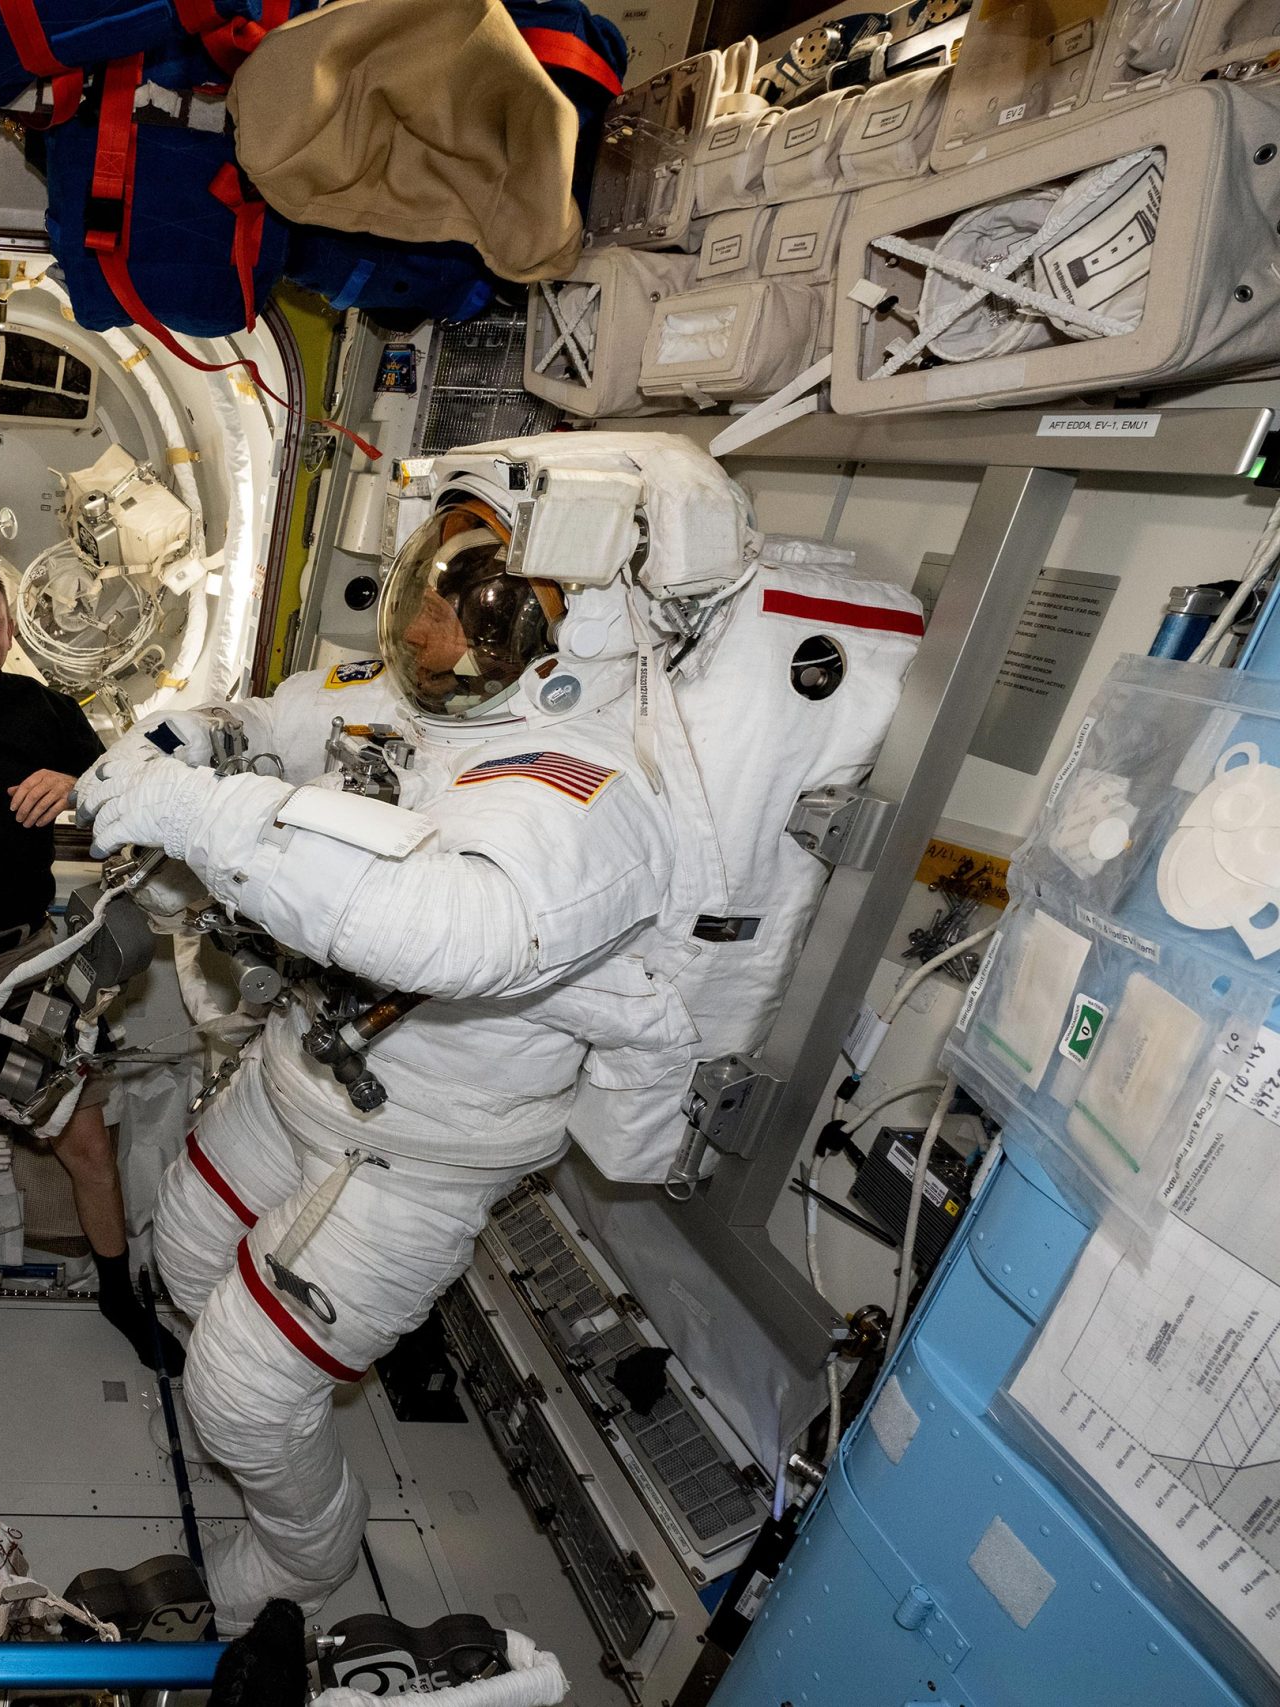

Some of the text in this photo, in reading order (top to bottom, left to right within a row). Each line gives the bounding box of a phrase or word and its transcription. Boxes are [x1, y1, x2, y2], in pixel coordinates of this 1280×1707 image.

[1005, 107, 1024, 119] EV 2
[1048, 421, 1066, 429] AFT
[1121, 421, 1148, 429] EMU1
[1081, 1026, 1090, 1036] 0
